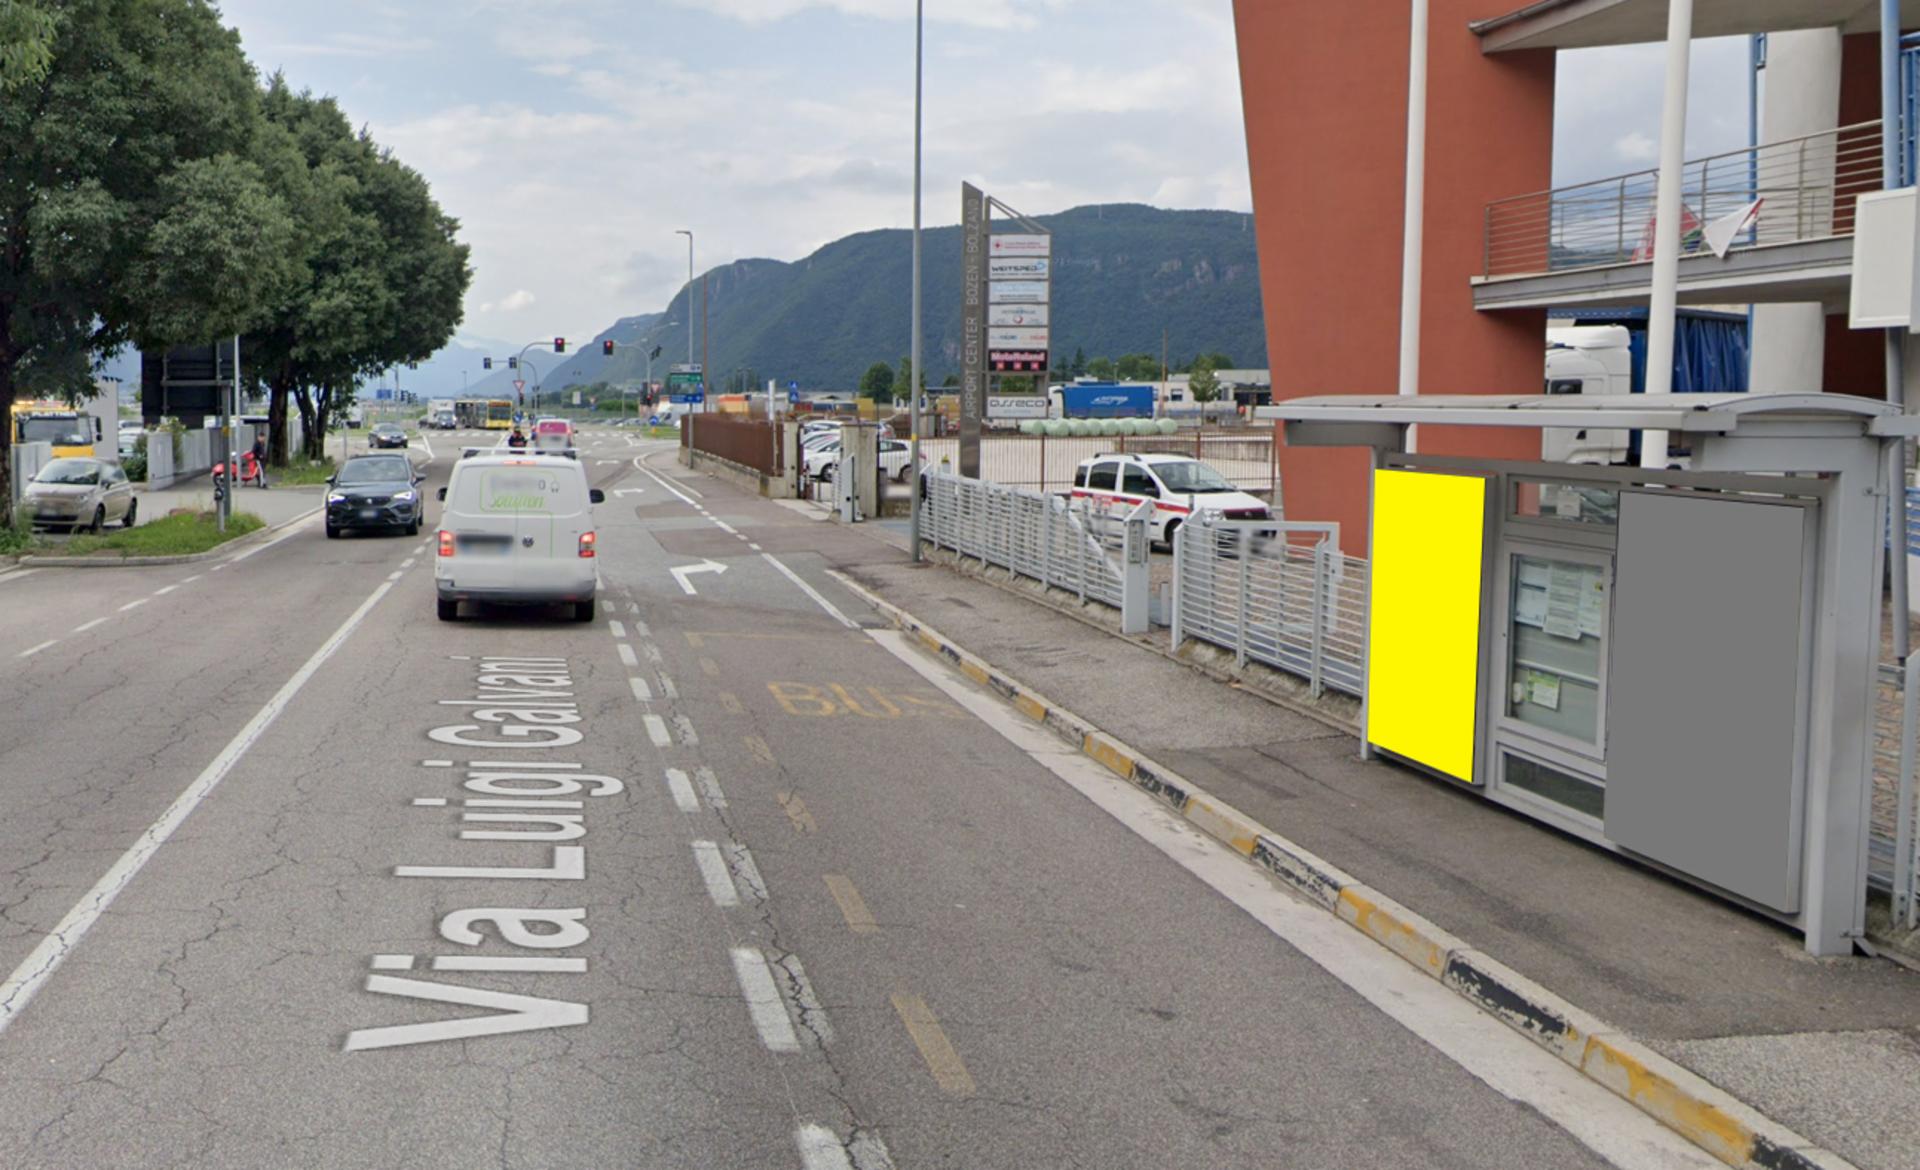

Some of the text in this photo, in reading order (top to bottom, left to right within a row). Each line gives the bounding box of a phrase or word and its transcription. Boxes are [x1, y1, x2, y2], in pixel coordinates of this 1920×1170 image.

[967, 198, 979, 254] BOLZANO
[966, 265, 979, 305] BOZEN
[966, 316, 978, 365] CENTER
[965, 369, 977, 420] AIRPORT
[767, 681, 980, 720] BUS
